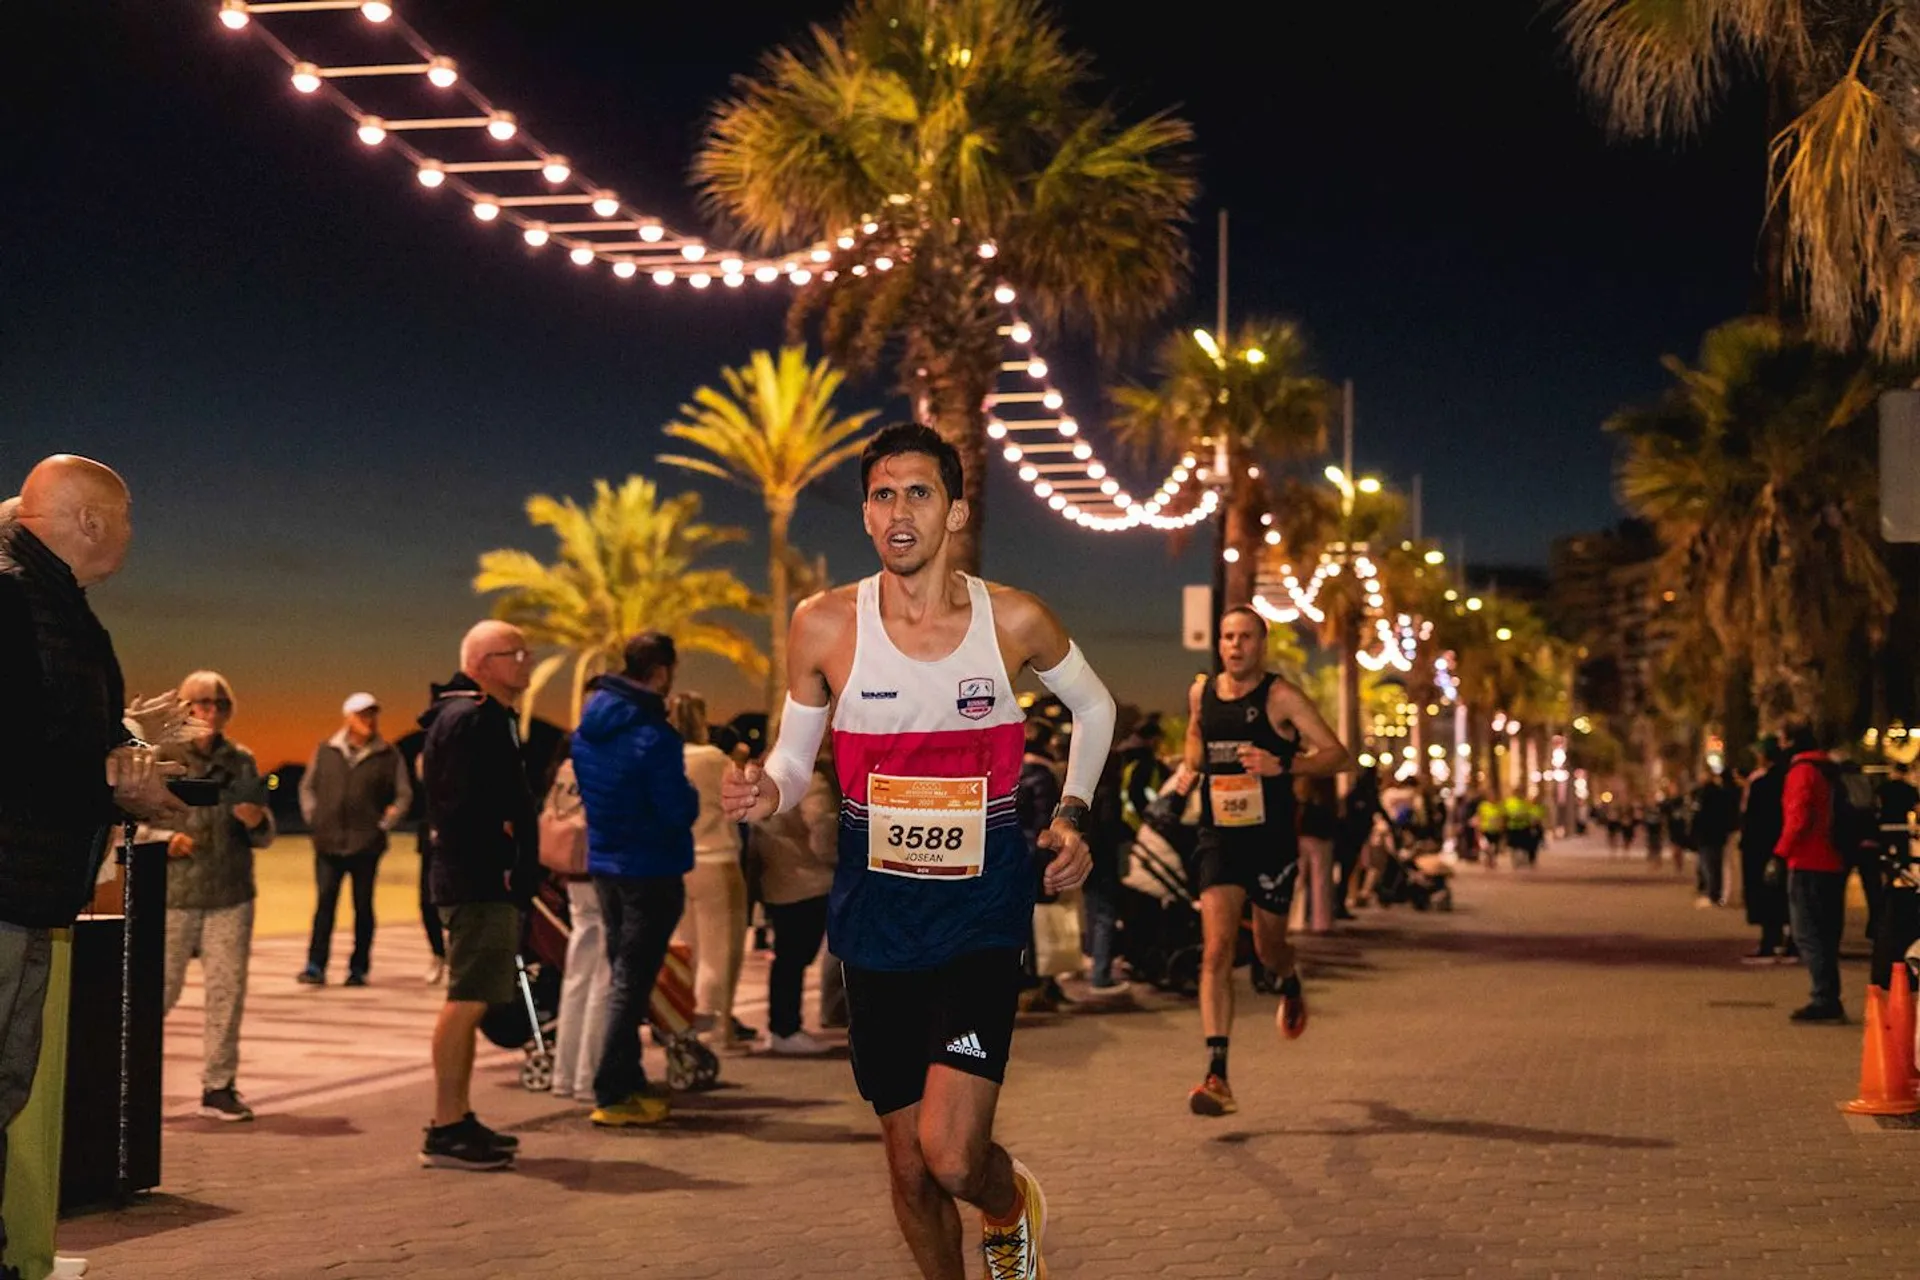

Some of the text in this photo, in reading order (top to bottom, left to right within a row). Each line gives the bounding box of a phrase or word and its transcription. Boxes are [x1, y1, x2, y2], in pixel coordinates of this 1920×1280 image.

[887, 824, 964, 851] 3588
[904, 853, 944, 863] JOSEAN
[946, 1044, 987, 1059] adidas
